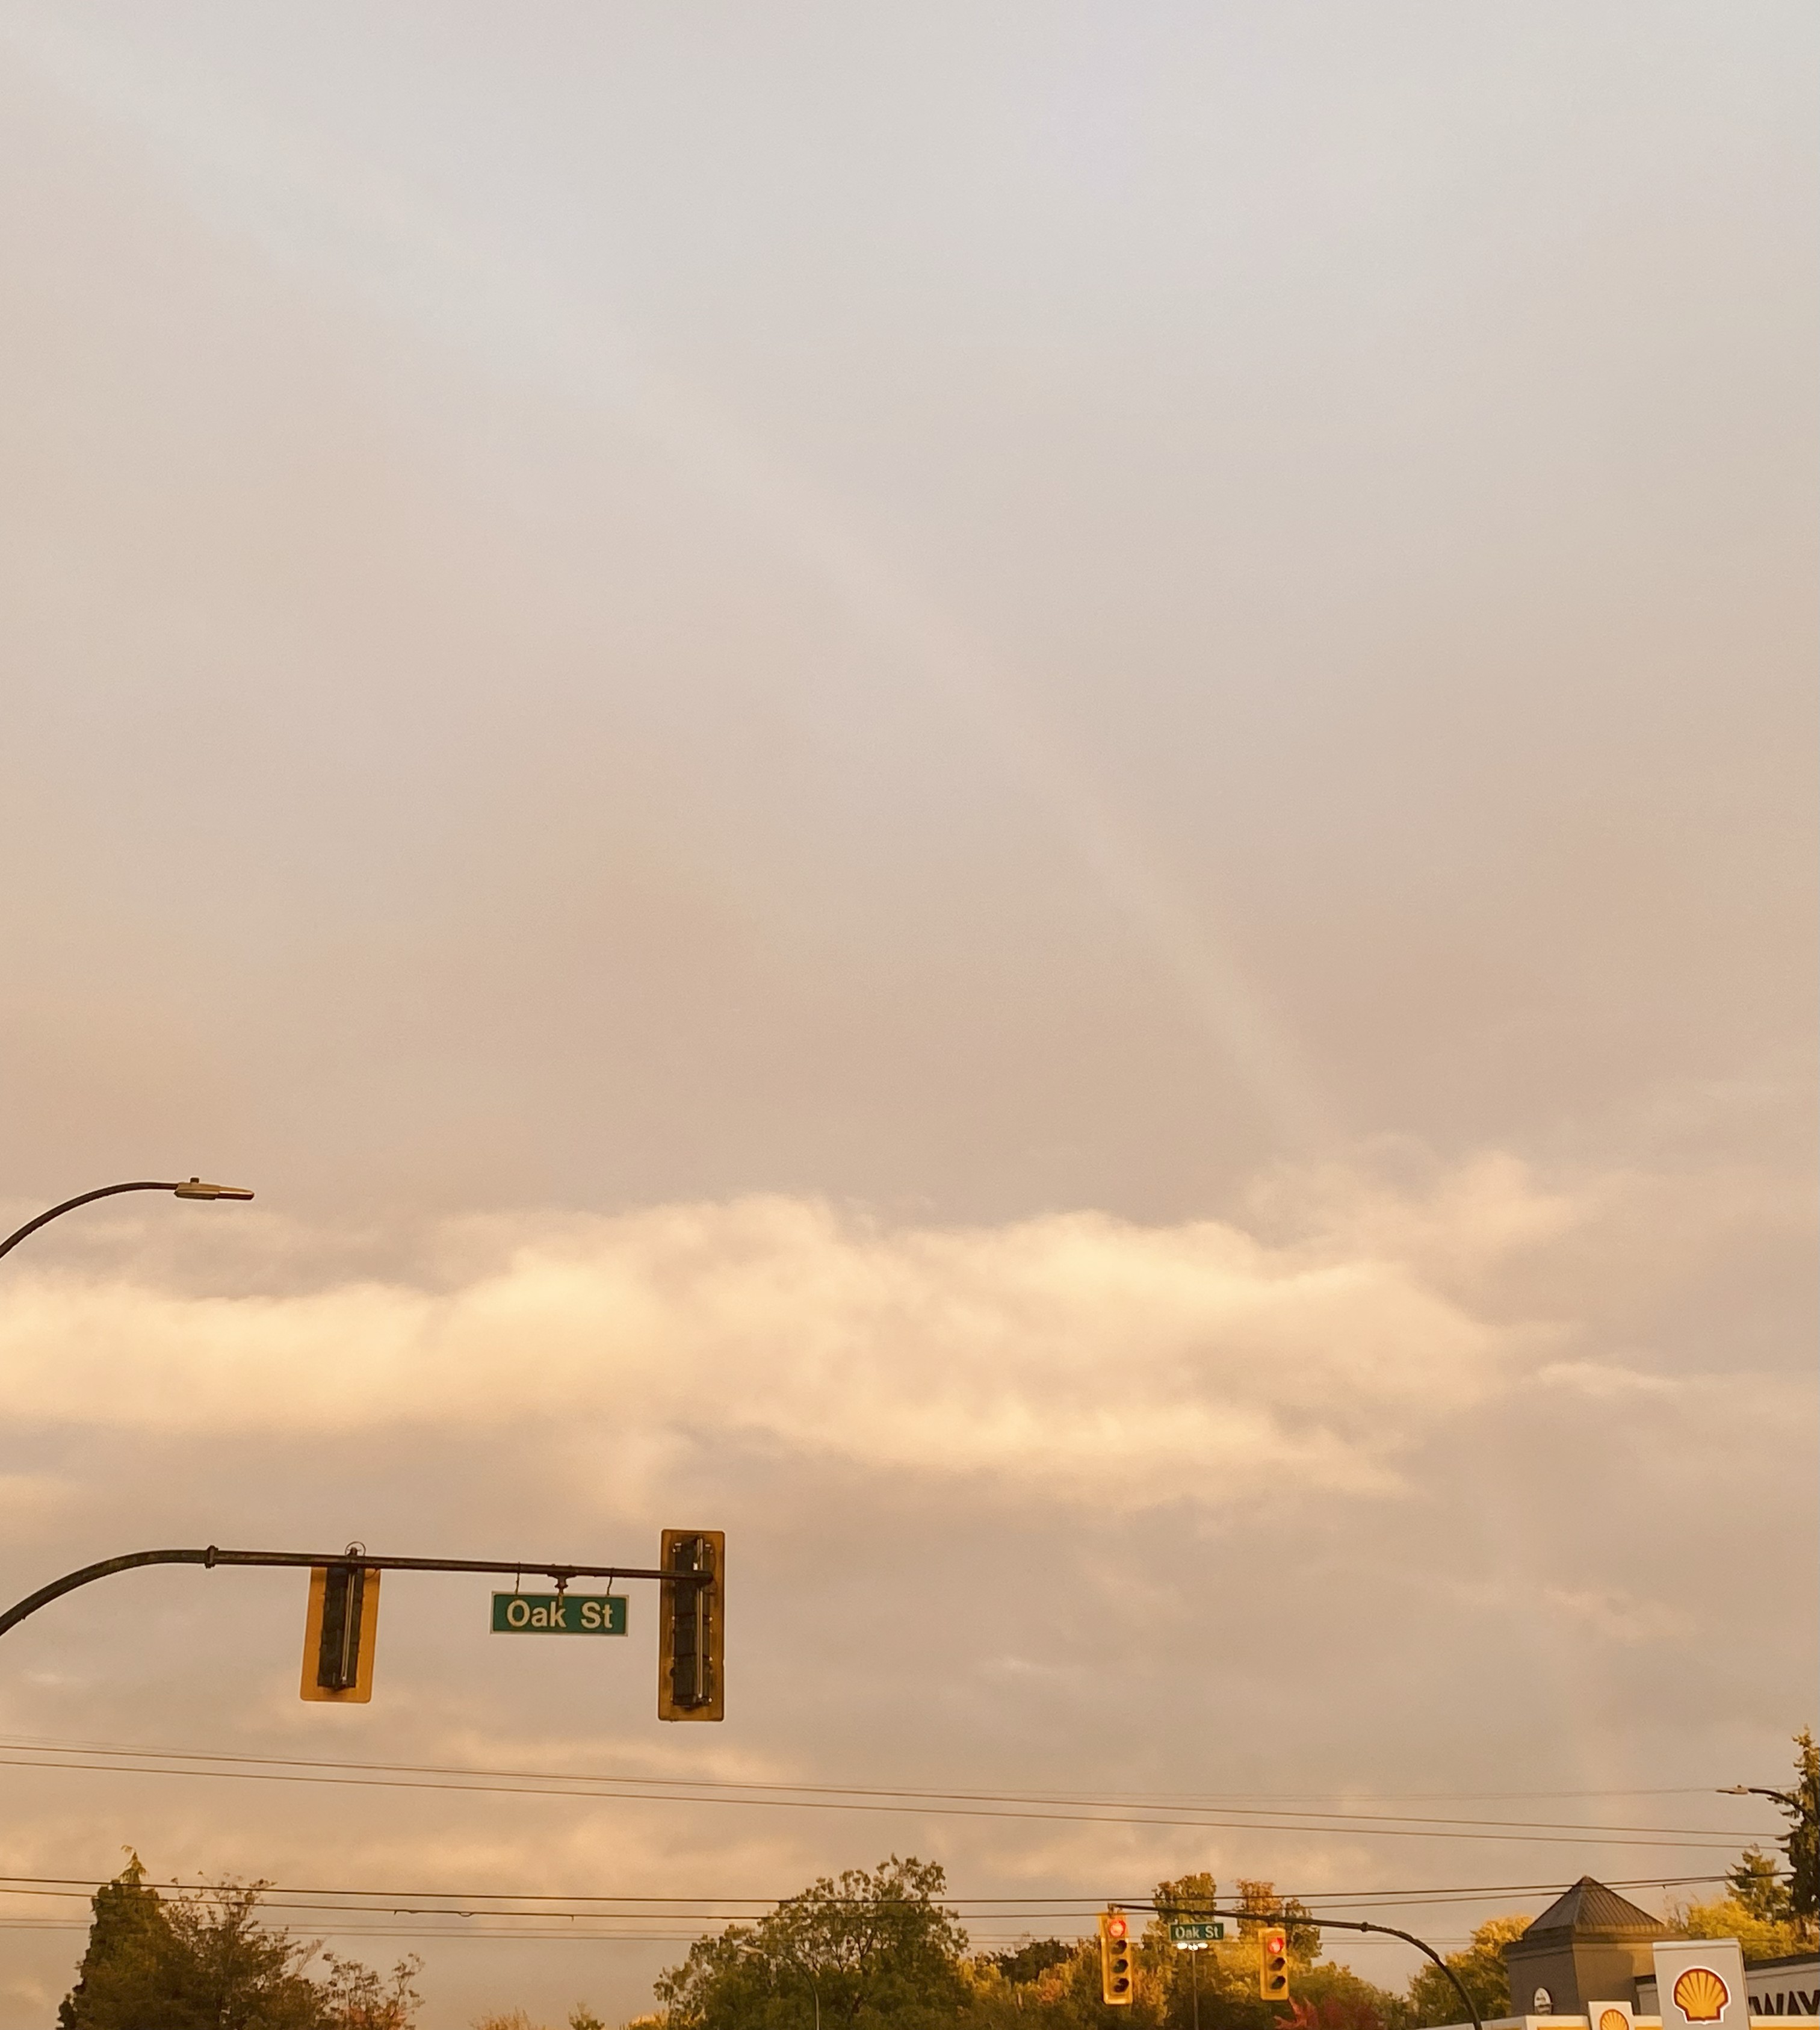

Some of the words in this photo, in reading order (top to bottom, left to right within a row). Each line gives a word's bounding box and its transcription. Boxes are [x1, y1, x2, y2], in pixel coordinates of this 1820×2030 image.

[507, 1599, 567, 1627] Oak
[581, 1601, 613, 1628] St
[1175, 1926, 1200, 1938] Oak
[1205, 1925, 1219, 1938] St
